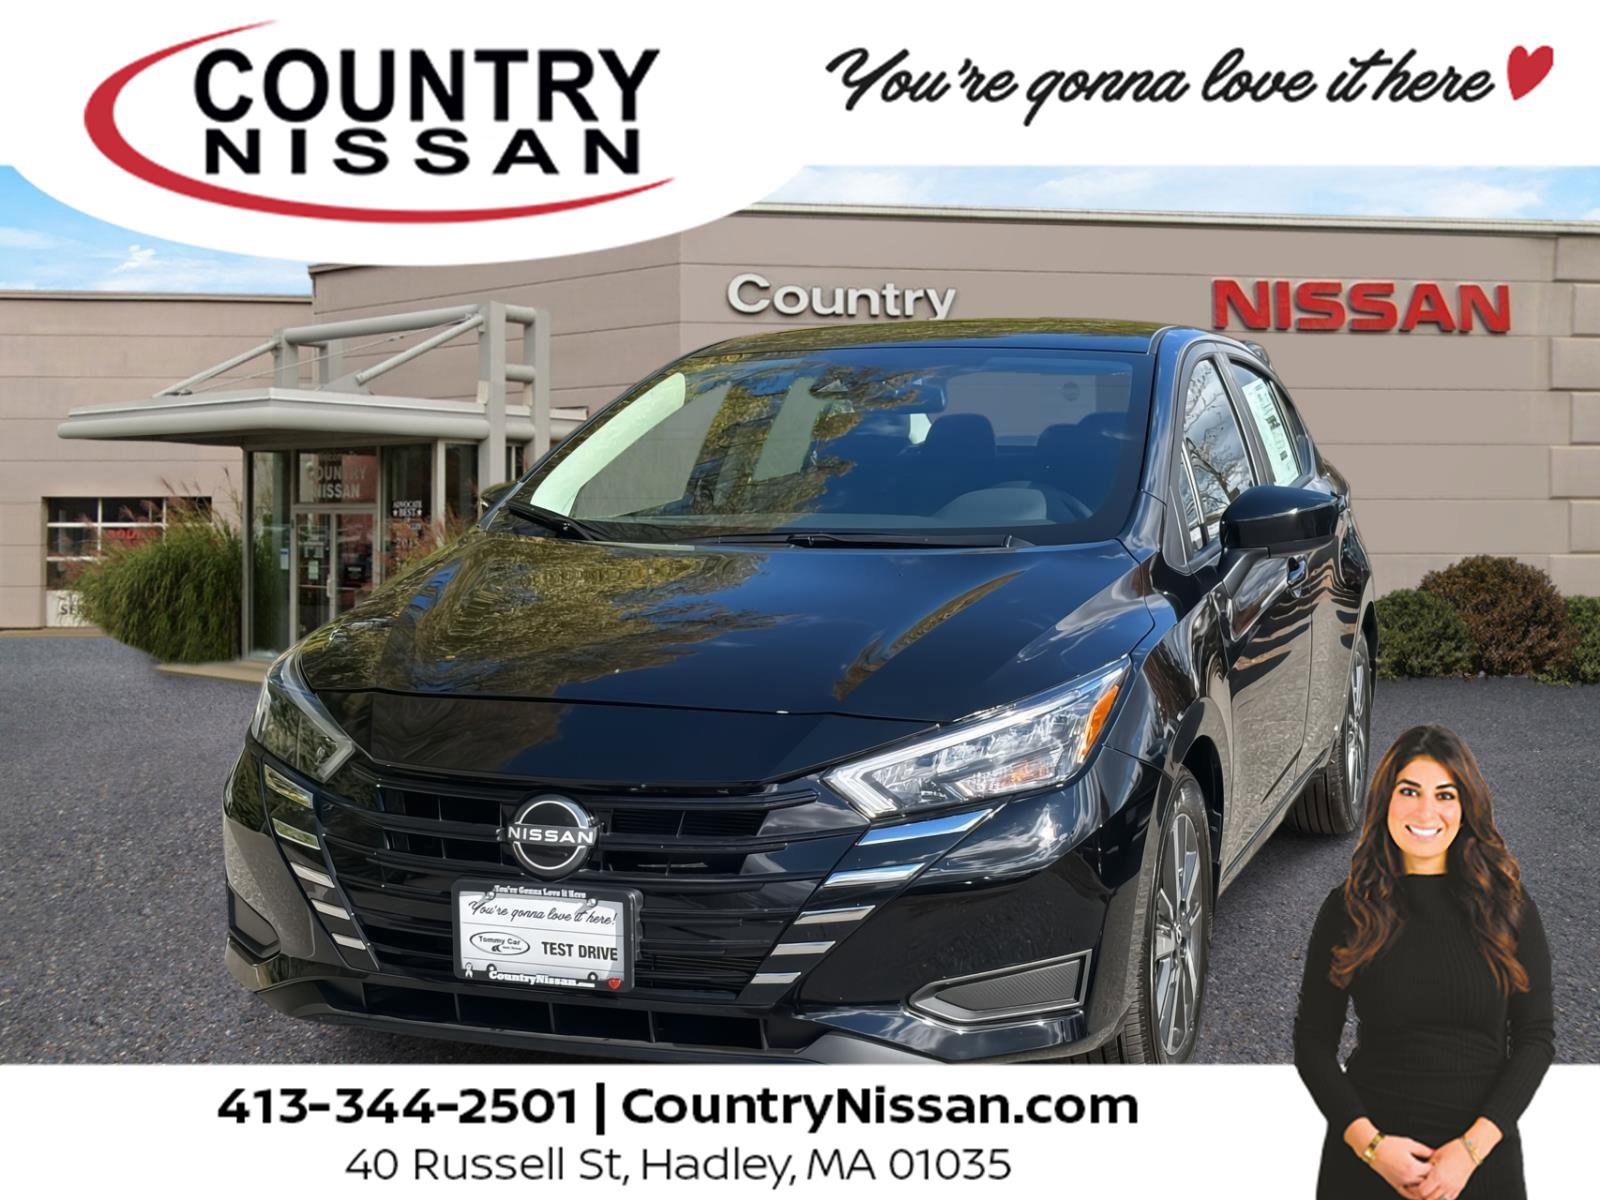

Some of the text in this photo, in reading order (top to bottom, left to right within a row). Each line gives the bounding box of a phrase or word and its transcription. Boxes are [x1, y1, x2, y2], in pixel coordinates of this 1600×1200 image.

[727, 272, 956, 321] Country
[1212, 279, 1511, 334] NISSAN
[507, 826, 594, 844] NISSAN
[468, 900, 618, 925] You're gonna love it here!
[541, 941, 618, 961] TEST DRIVE
